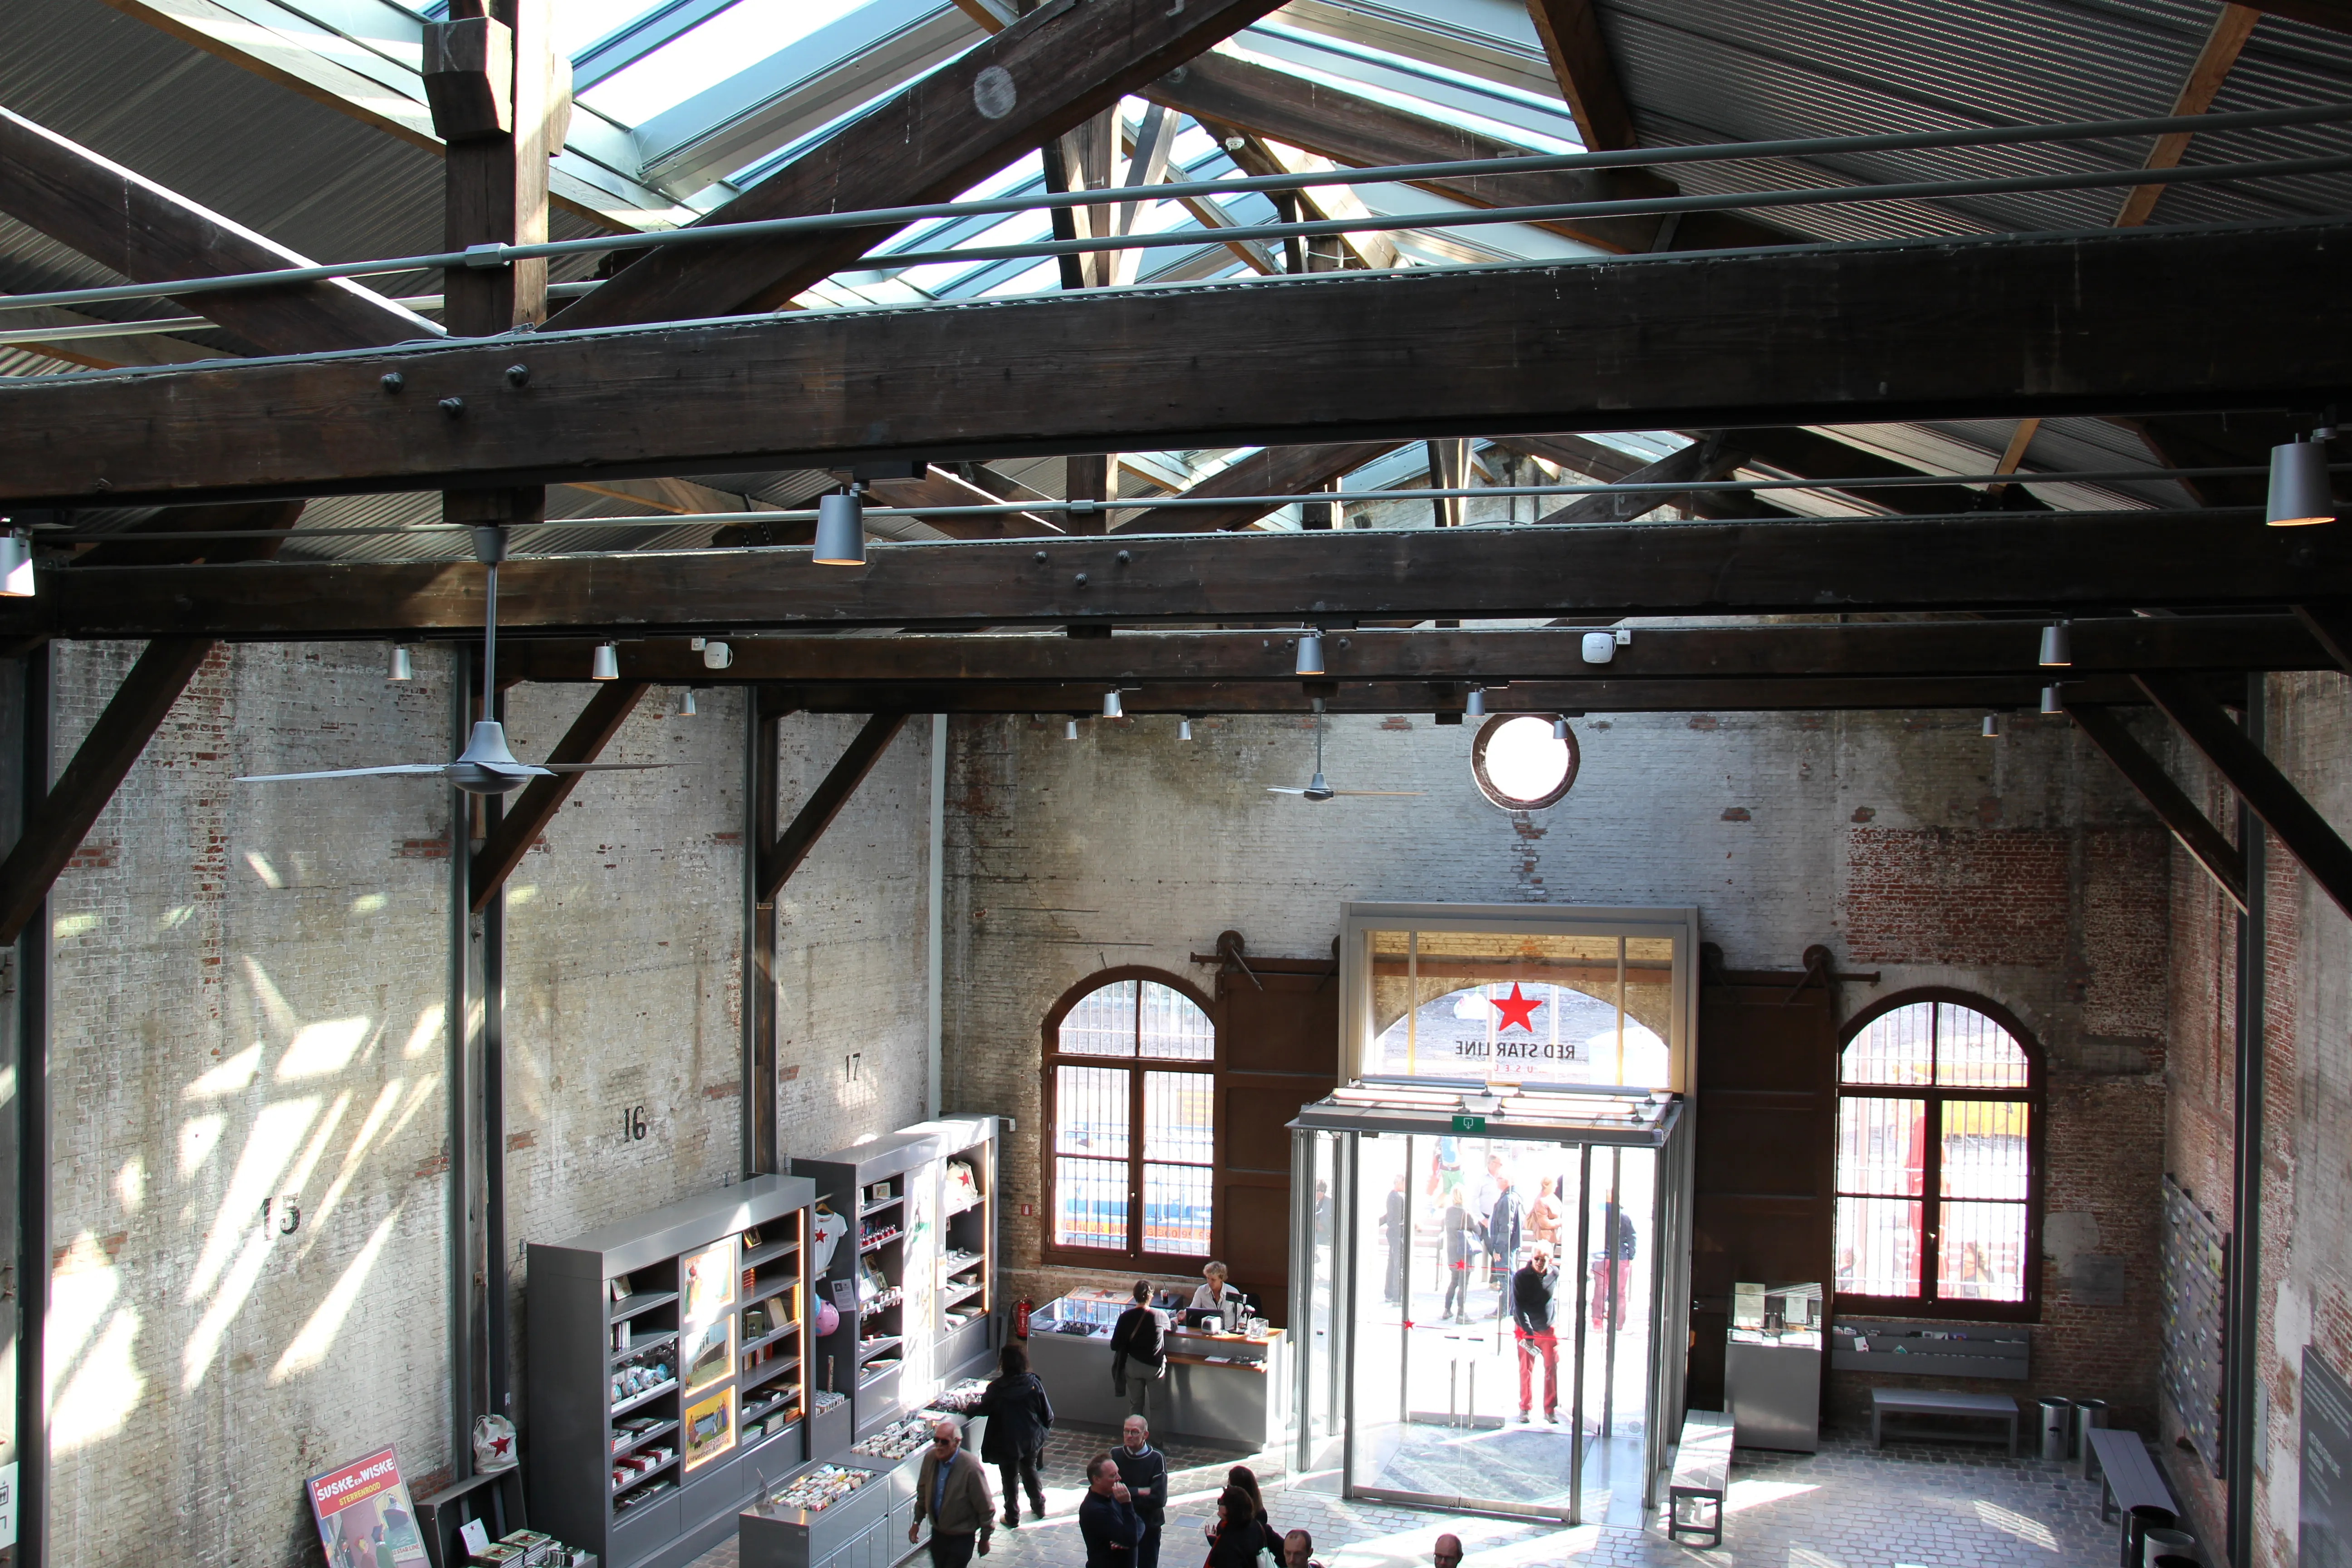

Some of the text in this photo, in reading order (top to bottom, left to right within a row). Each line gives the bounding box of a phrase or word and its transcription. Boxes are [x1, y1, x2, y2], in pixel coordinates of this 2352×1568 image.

[844, 1053, 861, 1083] 17
[622, 1105, 647, 1143] 16
[260, 1191, 300, 1241] 15
[317, 1475, 355, 1501] SUSKE
[360, 1458, 395, 1482] WISKE
[339, 1481, 381, 1506] STERRENROOD
